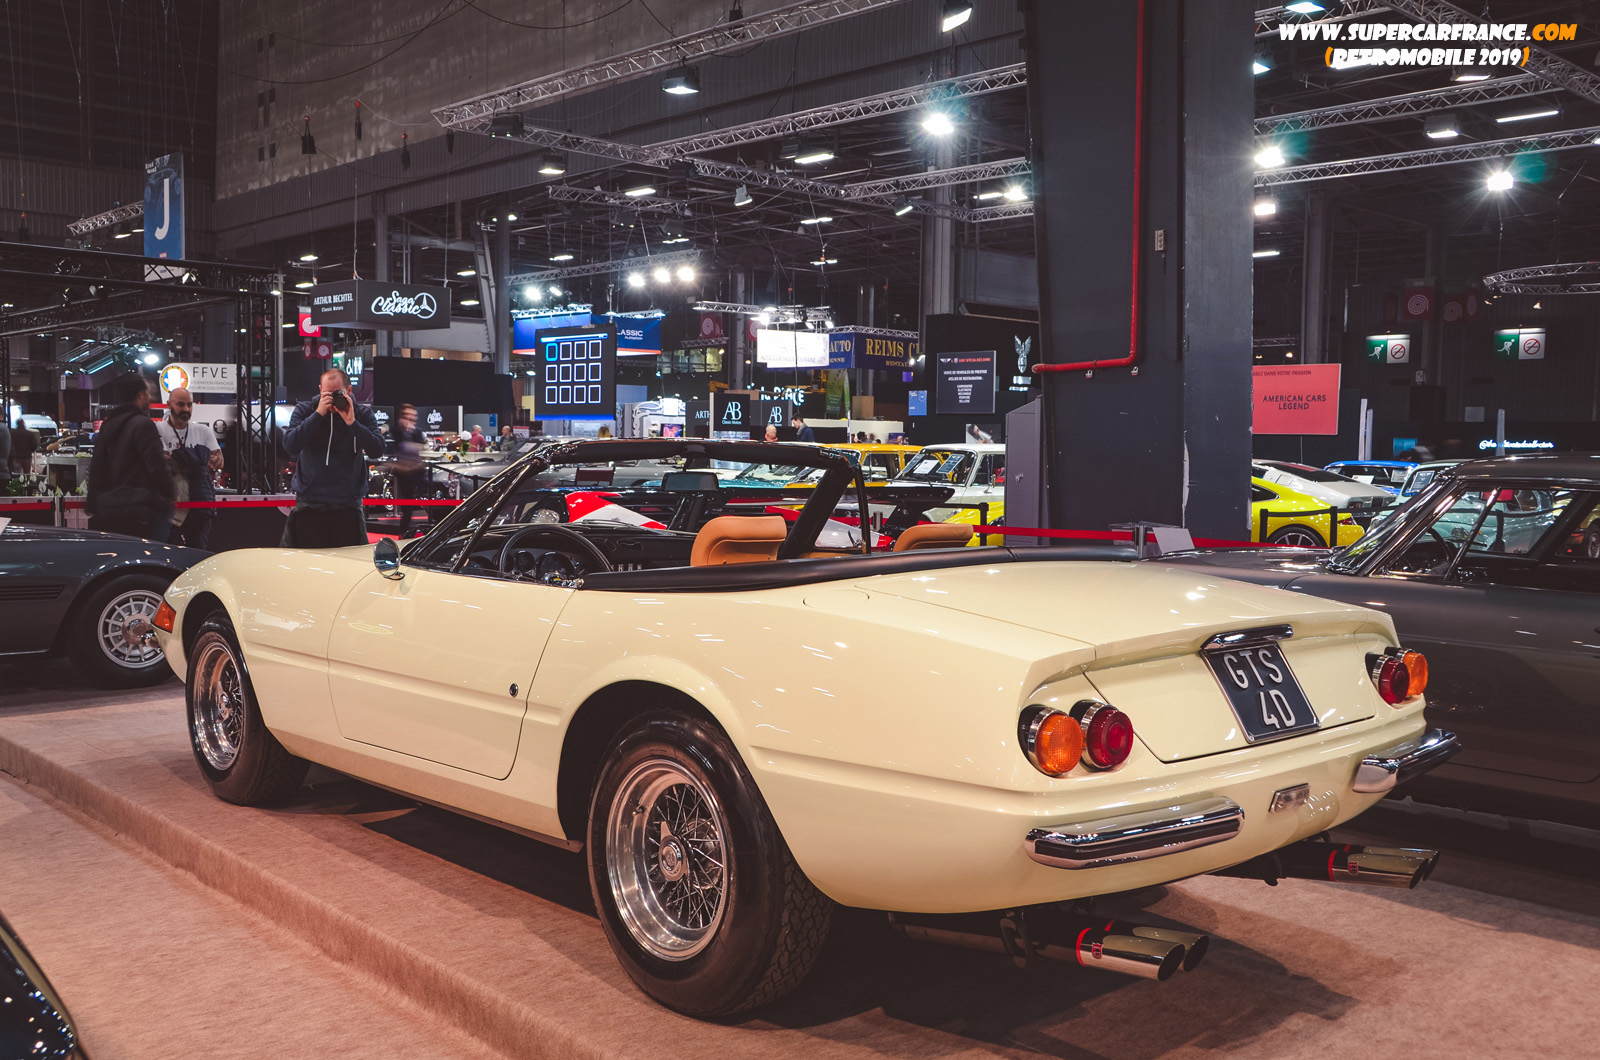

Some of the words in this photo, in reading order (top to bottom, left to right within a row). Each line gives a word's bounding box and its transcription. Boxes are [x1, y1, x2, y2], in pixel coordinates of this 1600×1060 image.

[155, 178, 170, 240] J
[314, 295, 332, 305] ARTHUR
[333, 293, 353, 303] BECHTEL
[371, 296, 422, 316] Classic
[390, 290, 415, 305] Saga
[829, 340, 852, 352] AUTO
[865, 338, 904, 358] REIMS
[193, 367, 228, 379] FFVE
[722, 401, 742, 421] AB
[768, 406, 783, 423] AB
[1223, 648, 1283, 689] GTS
